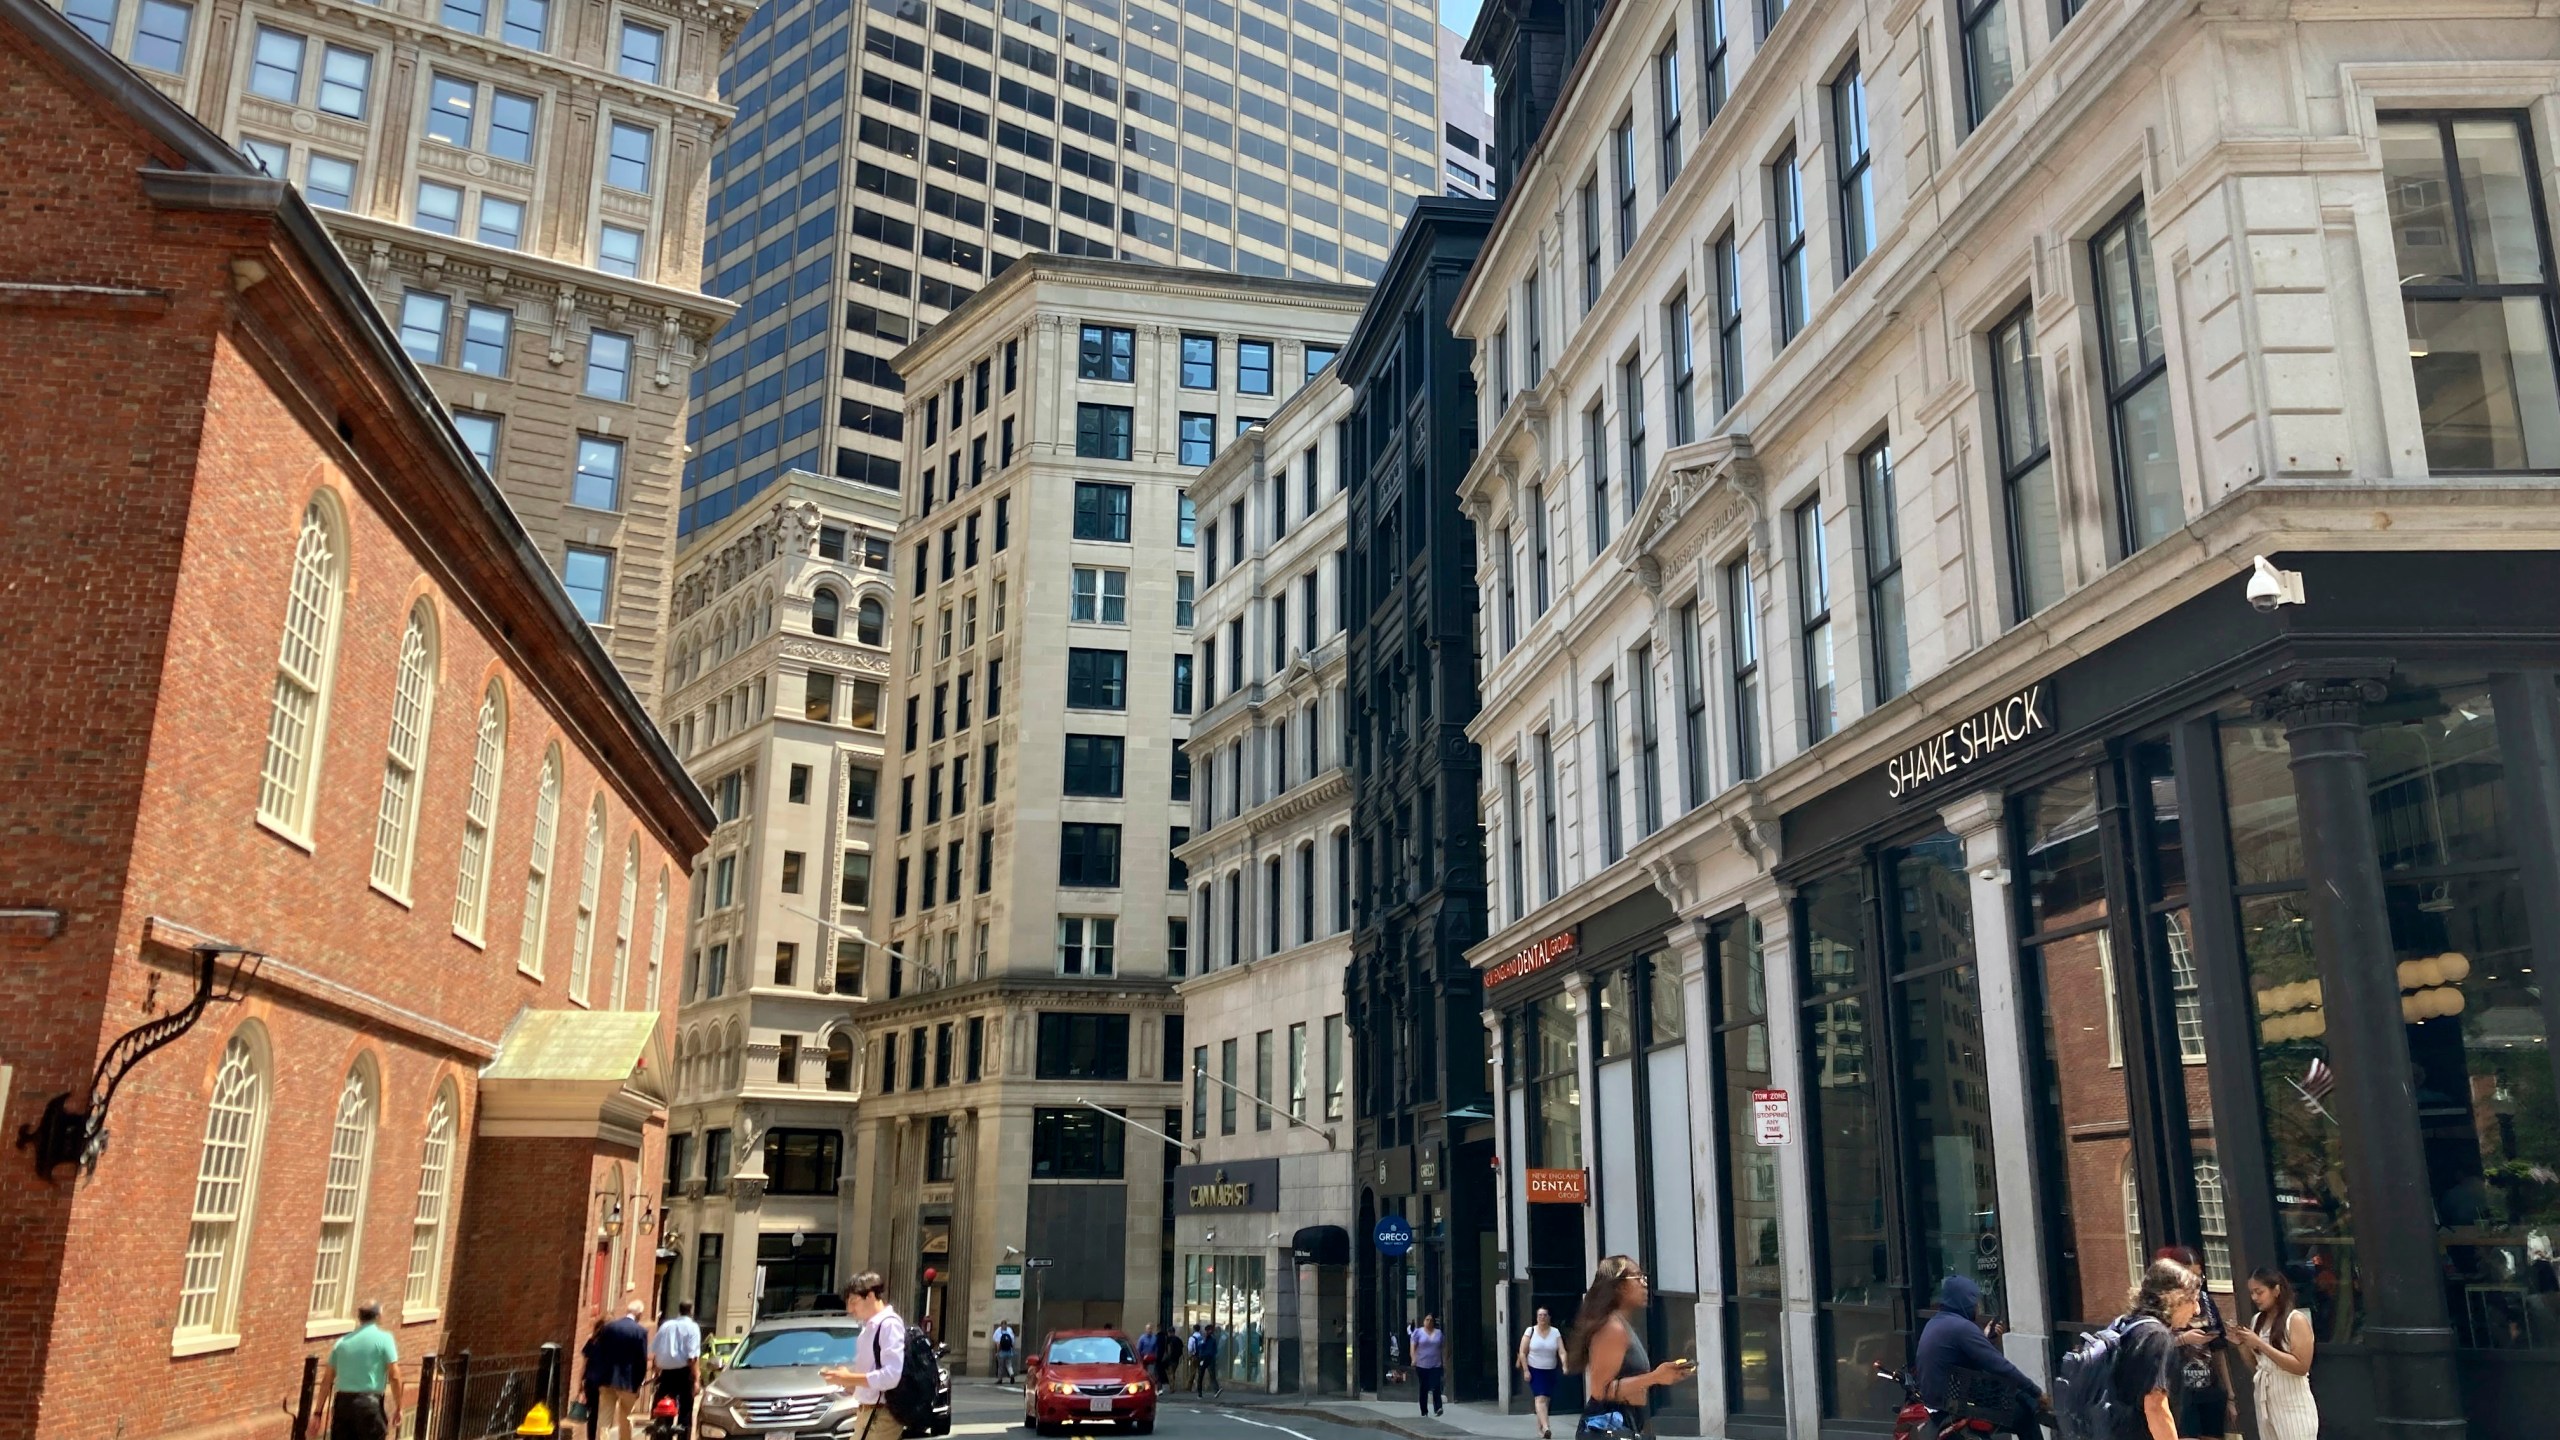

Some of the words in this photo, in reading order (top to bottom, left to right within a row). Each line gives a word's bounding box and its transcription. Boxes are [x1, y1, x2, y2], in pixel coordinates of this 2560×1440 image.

[1662, 527, 1709, 585] TRANSCRIPT
[1710, 499, 1744, 540] BUILDI
[1888, 729, 1957, 799] SHAKE
[1960, 686, 2043, 764] SHACK
[1494, 959, 1517, 983] ENGLAND
[1517, 939, 1550, 976] DENTAL
[1550, 932, 1569, 957] GROUP
[1189, 1182, 1248, 1208] CANNABIST
[1532, 1181, 1579, 1191] DENTAL
[1379, 1232, 1409, 1241] GRECO
